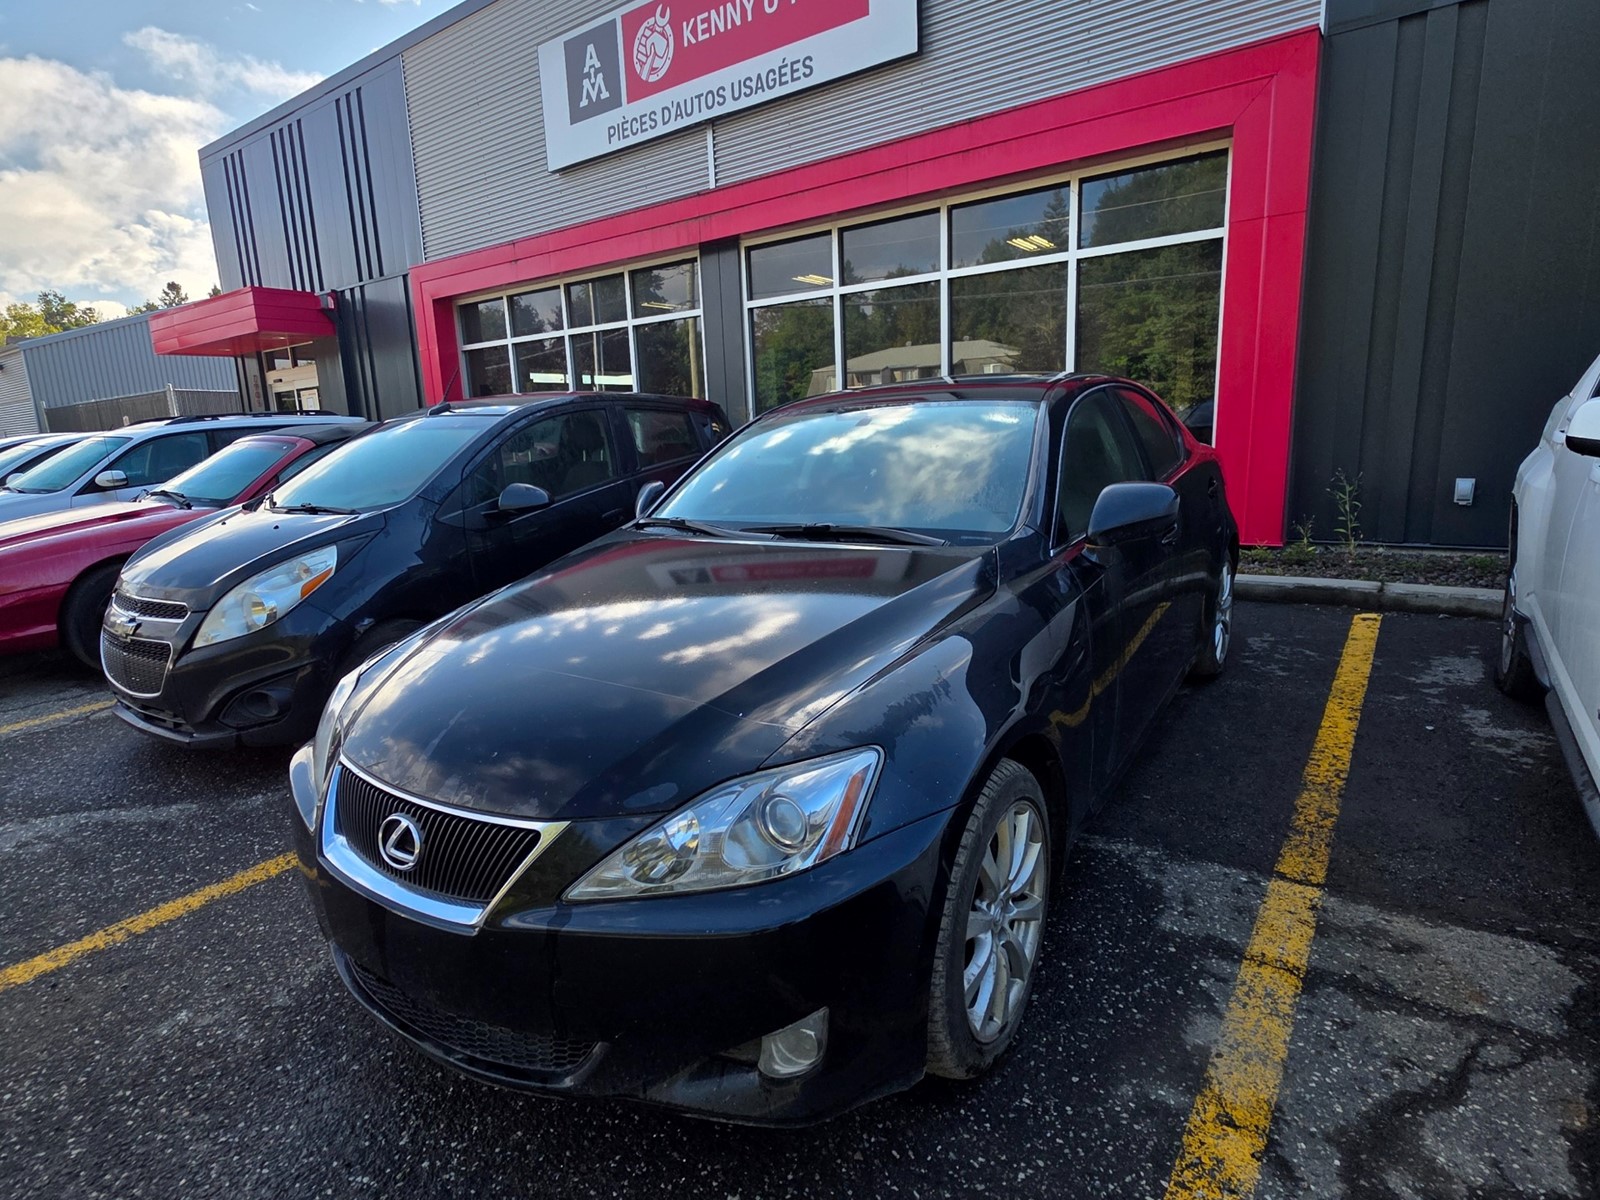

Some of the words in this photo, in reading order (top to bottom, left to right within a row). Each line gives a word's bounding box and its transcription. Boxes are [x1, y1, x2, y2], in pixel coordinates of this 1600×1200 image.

[682, 0, 754, 48] KENNY
[606, 110, 658, 145] PIÈCES
[661, 85, 727, 126] D'AUTOS
[731, 55, 814, 102] USAGÉES
